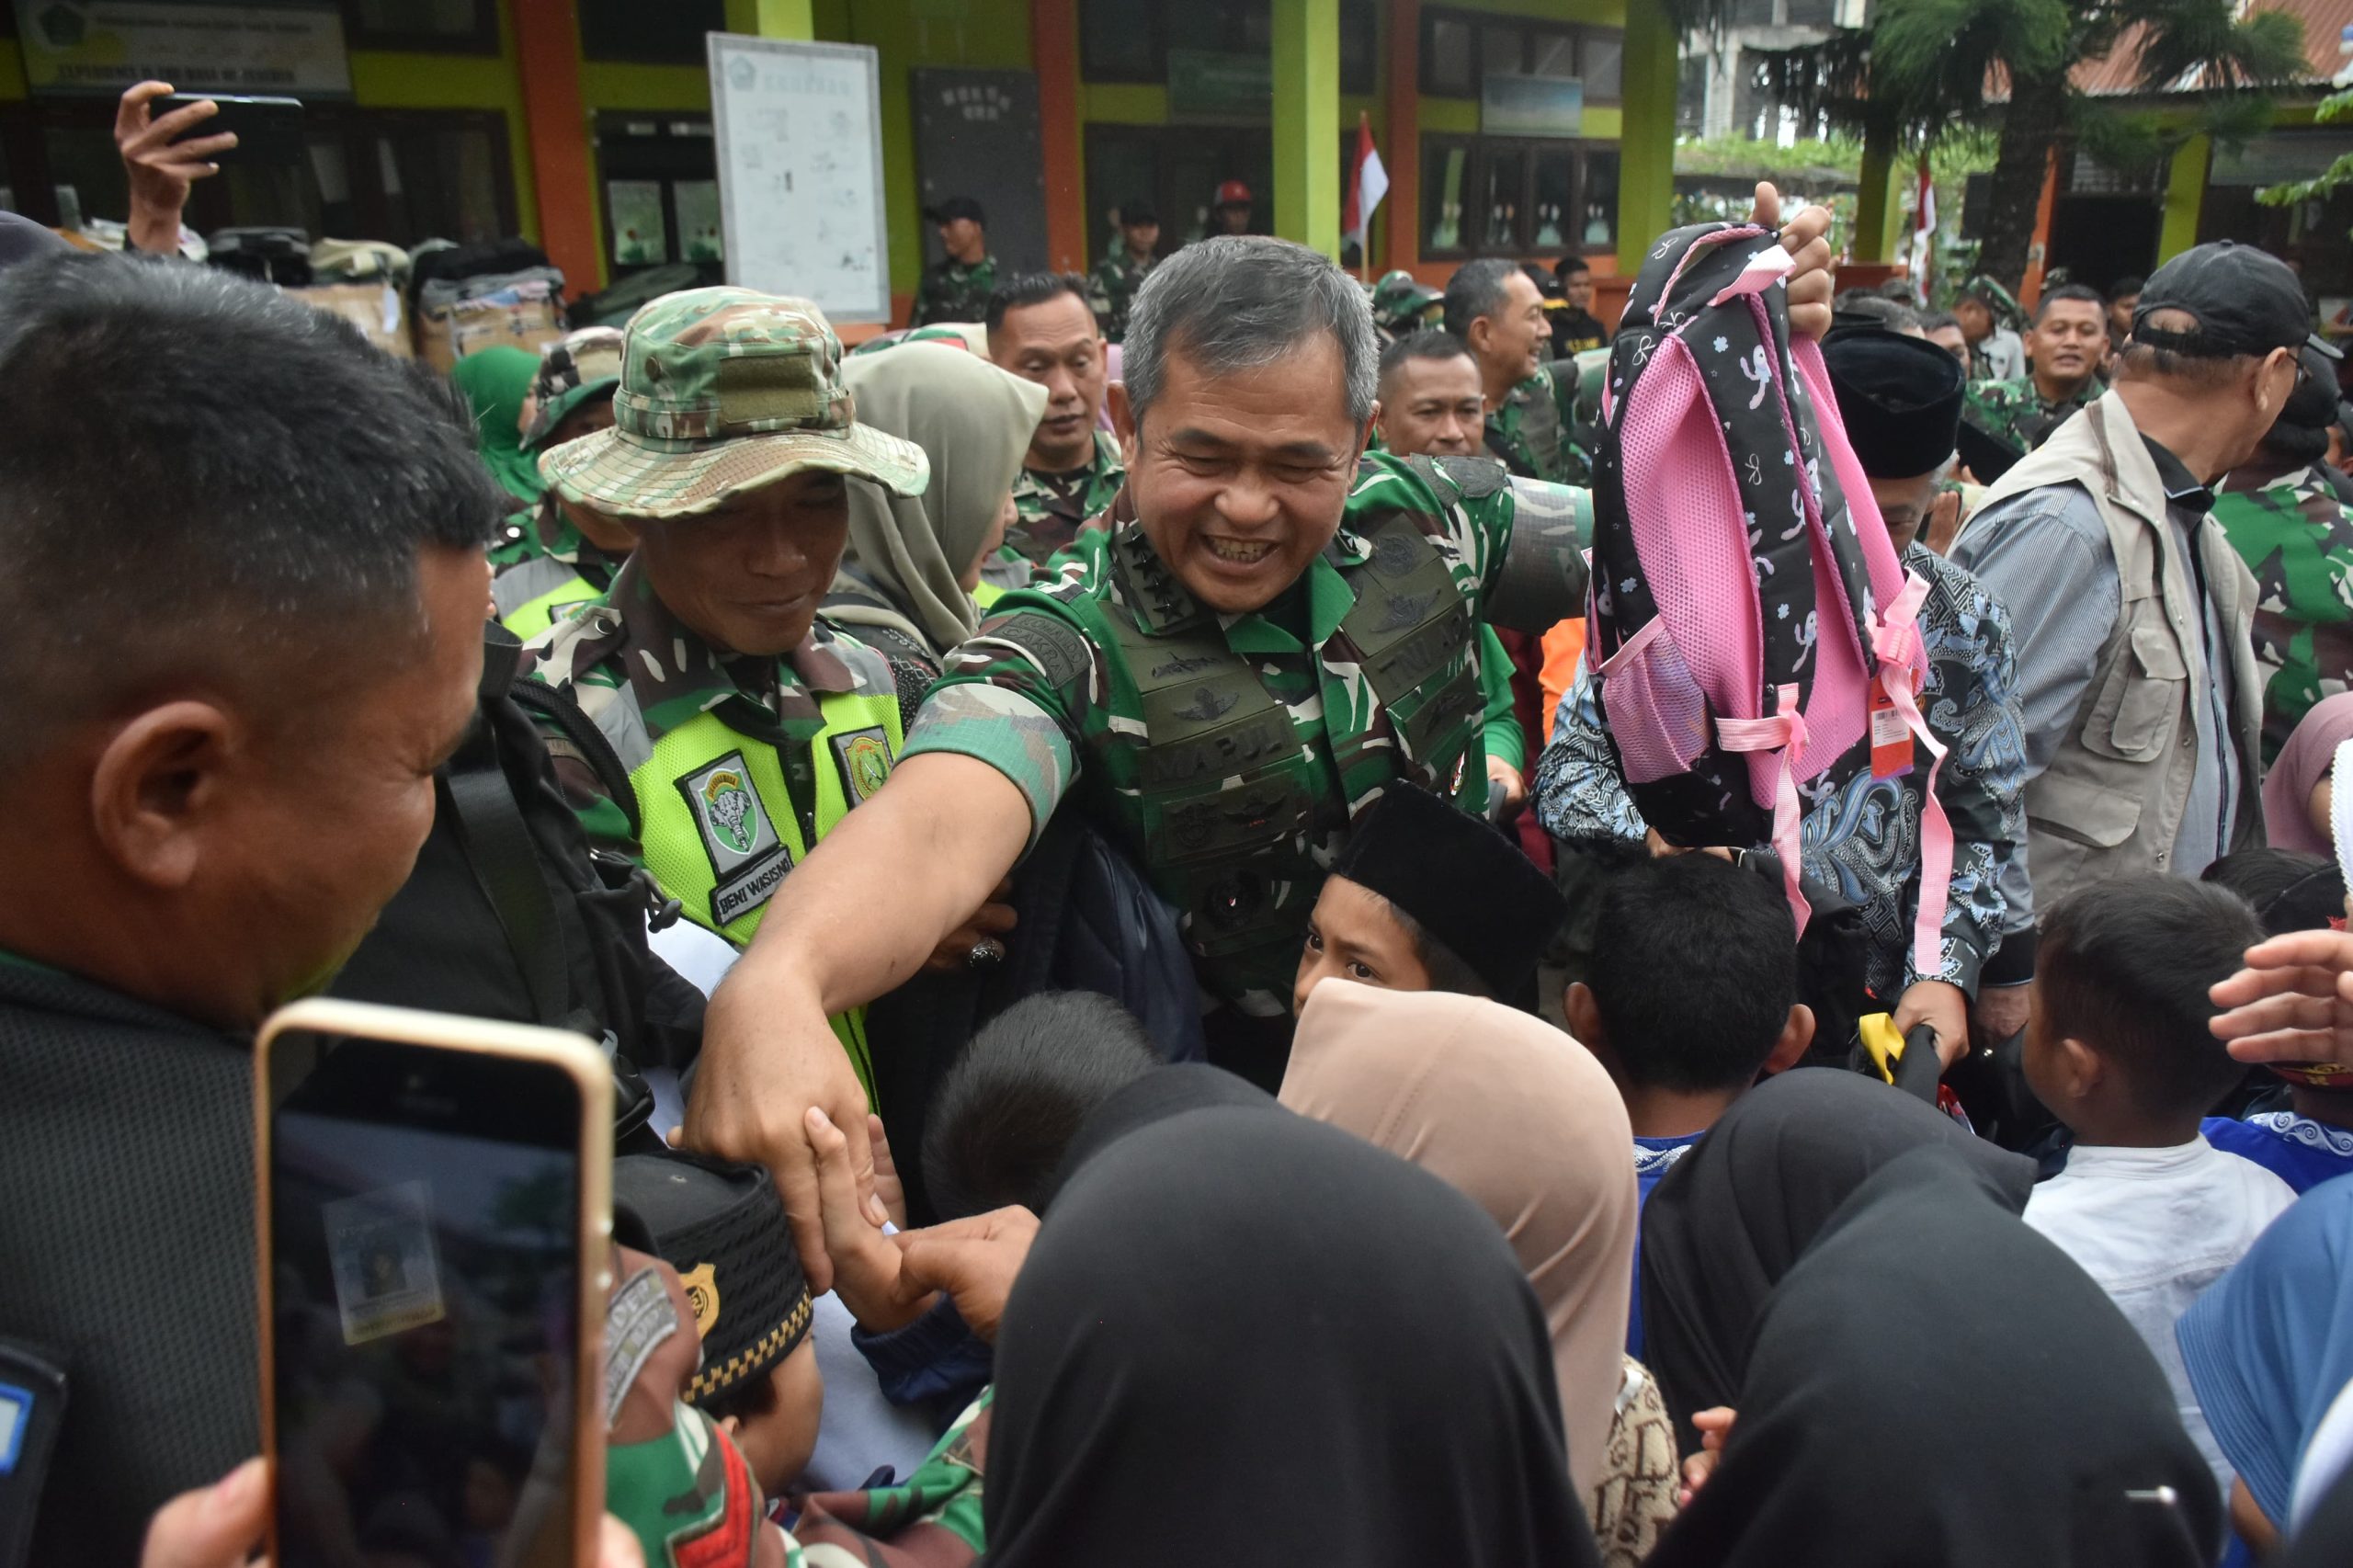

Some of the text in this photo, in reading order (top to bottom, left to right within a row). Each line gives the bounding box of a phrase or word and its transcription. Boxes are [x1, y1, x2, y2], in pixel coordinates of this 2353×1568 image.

[1002, 627, 1064, 678] CAKRA
[1019, 617, 1084, 665] KOMANDO
[1378, 636, 1432, 688] TNI
[1150, 718, 1287, 780] MARULI
[719, 887, 748, 915] BENI
